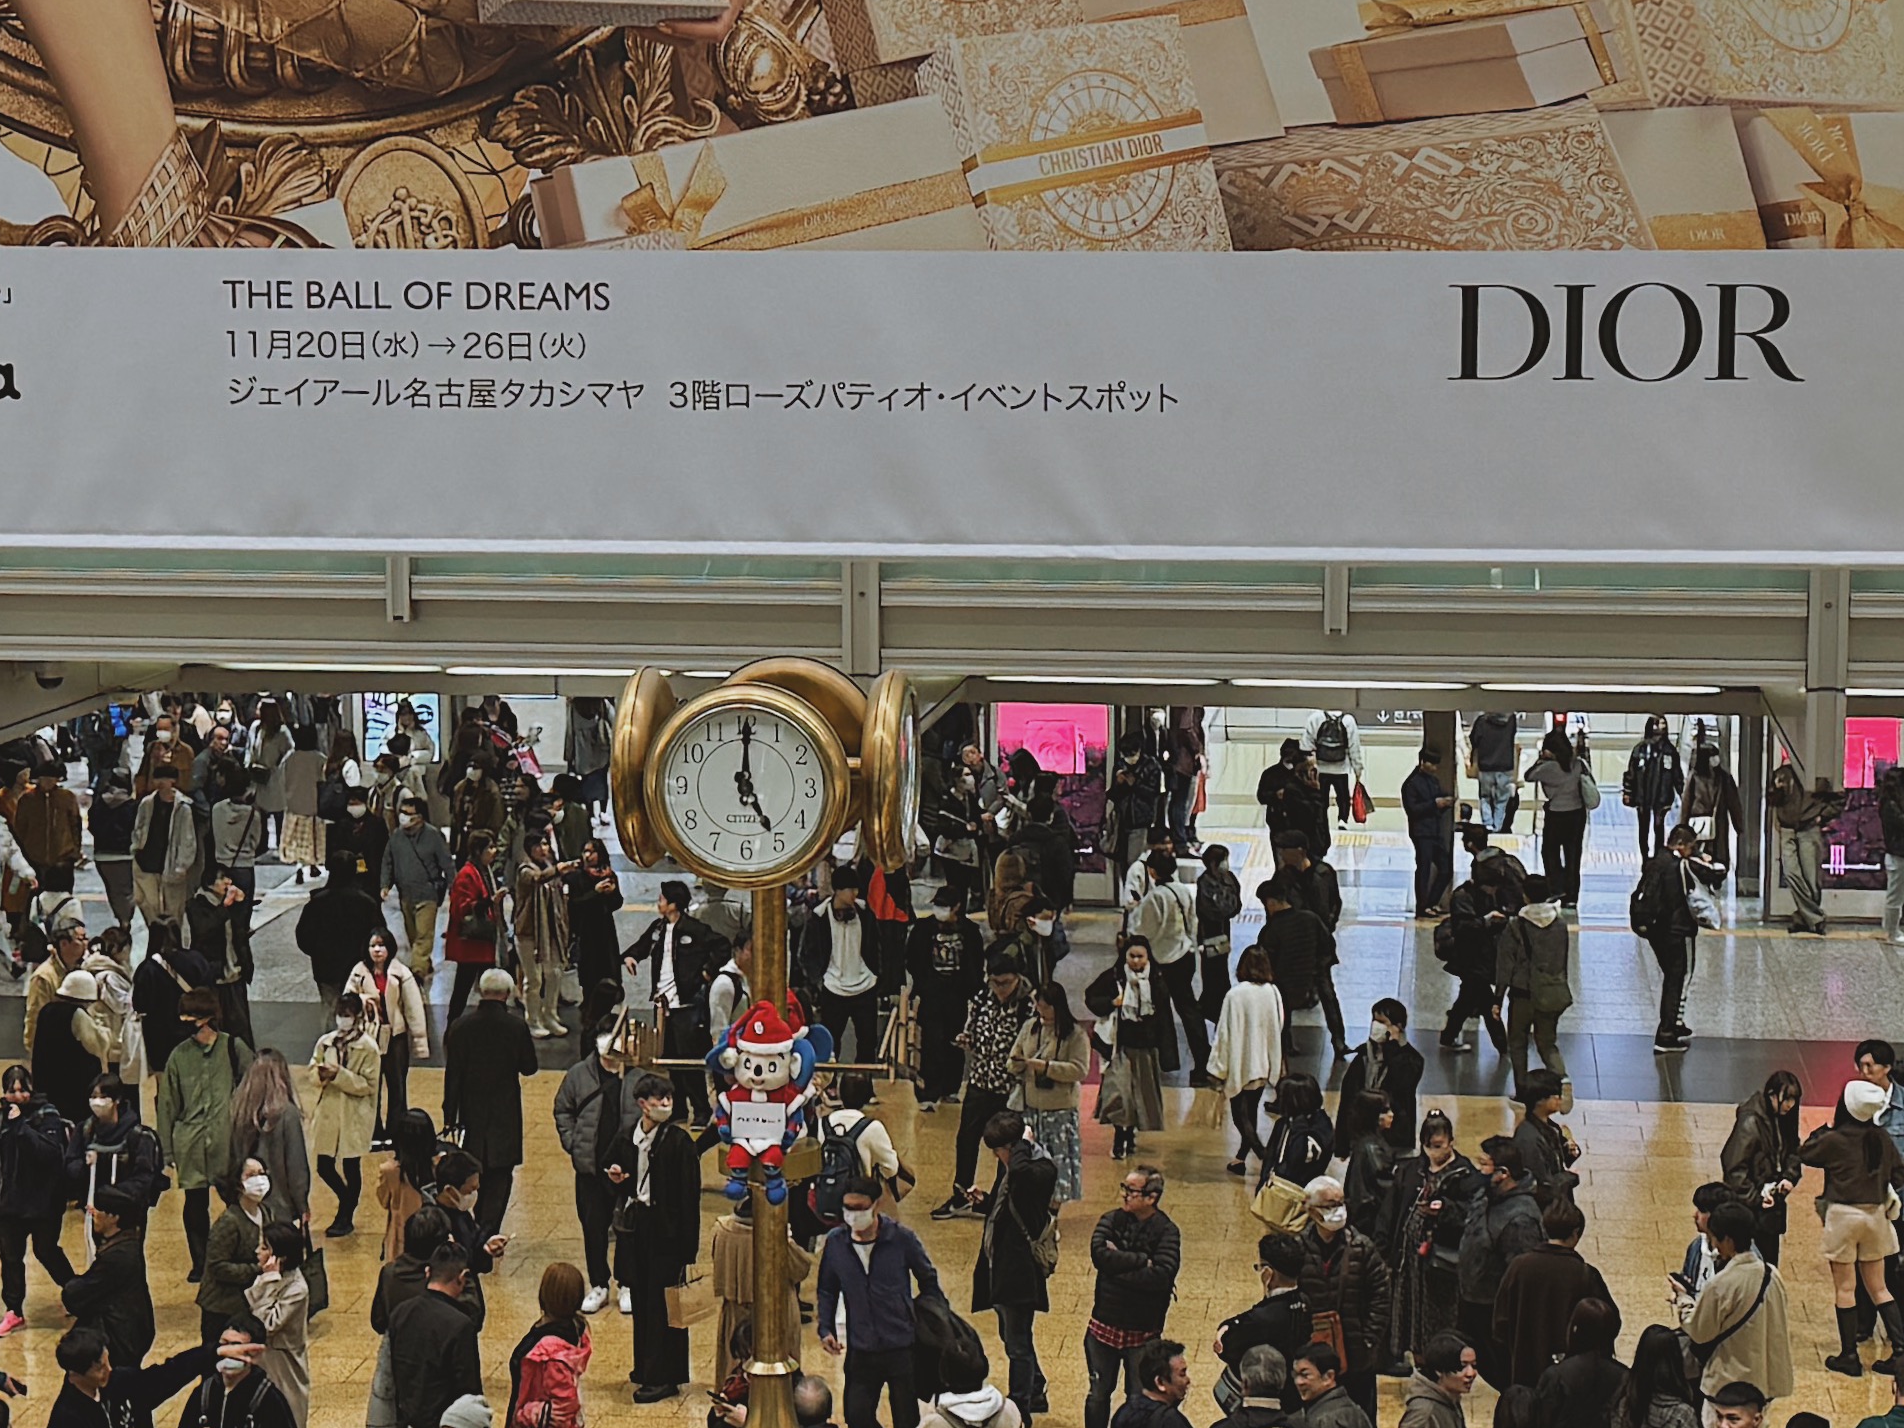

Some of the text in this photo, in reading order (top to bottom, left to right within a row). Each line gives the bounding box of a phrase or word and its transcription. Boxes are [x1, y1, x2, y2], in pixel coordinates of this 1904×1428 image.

[1039, 133, 1165, 176] CHRISTIAN DIOR
[1783, 210, 1821, 227] DIOR
[222, 279, 611, 312] THE BALL OF DREAMS
[1446, 281, 1807, 384] DIOR
[228, 375, 1179, 414] ジェイアール名古屋タカシマヤ 3階ローズパティオ・イベントスポット
[705, 722, 724, 742] 11
[683, 743, 704, 764] 10
[795, 744, 808, 766] 2
[675, 775, 688, 795] 9
[804, 777, 817, 798] 3
[684, 809, 697, 830] 8
[794, 809, 806, 829] 4
[708, 832, 721, 852] 7
[740, 840, 753, 860] 6
[772, 832, 785, 853] 5
